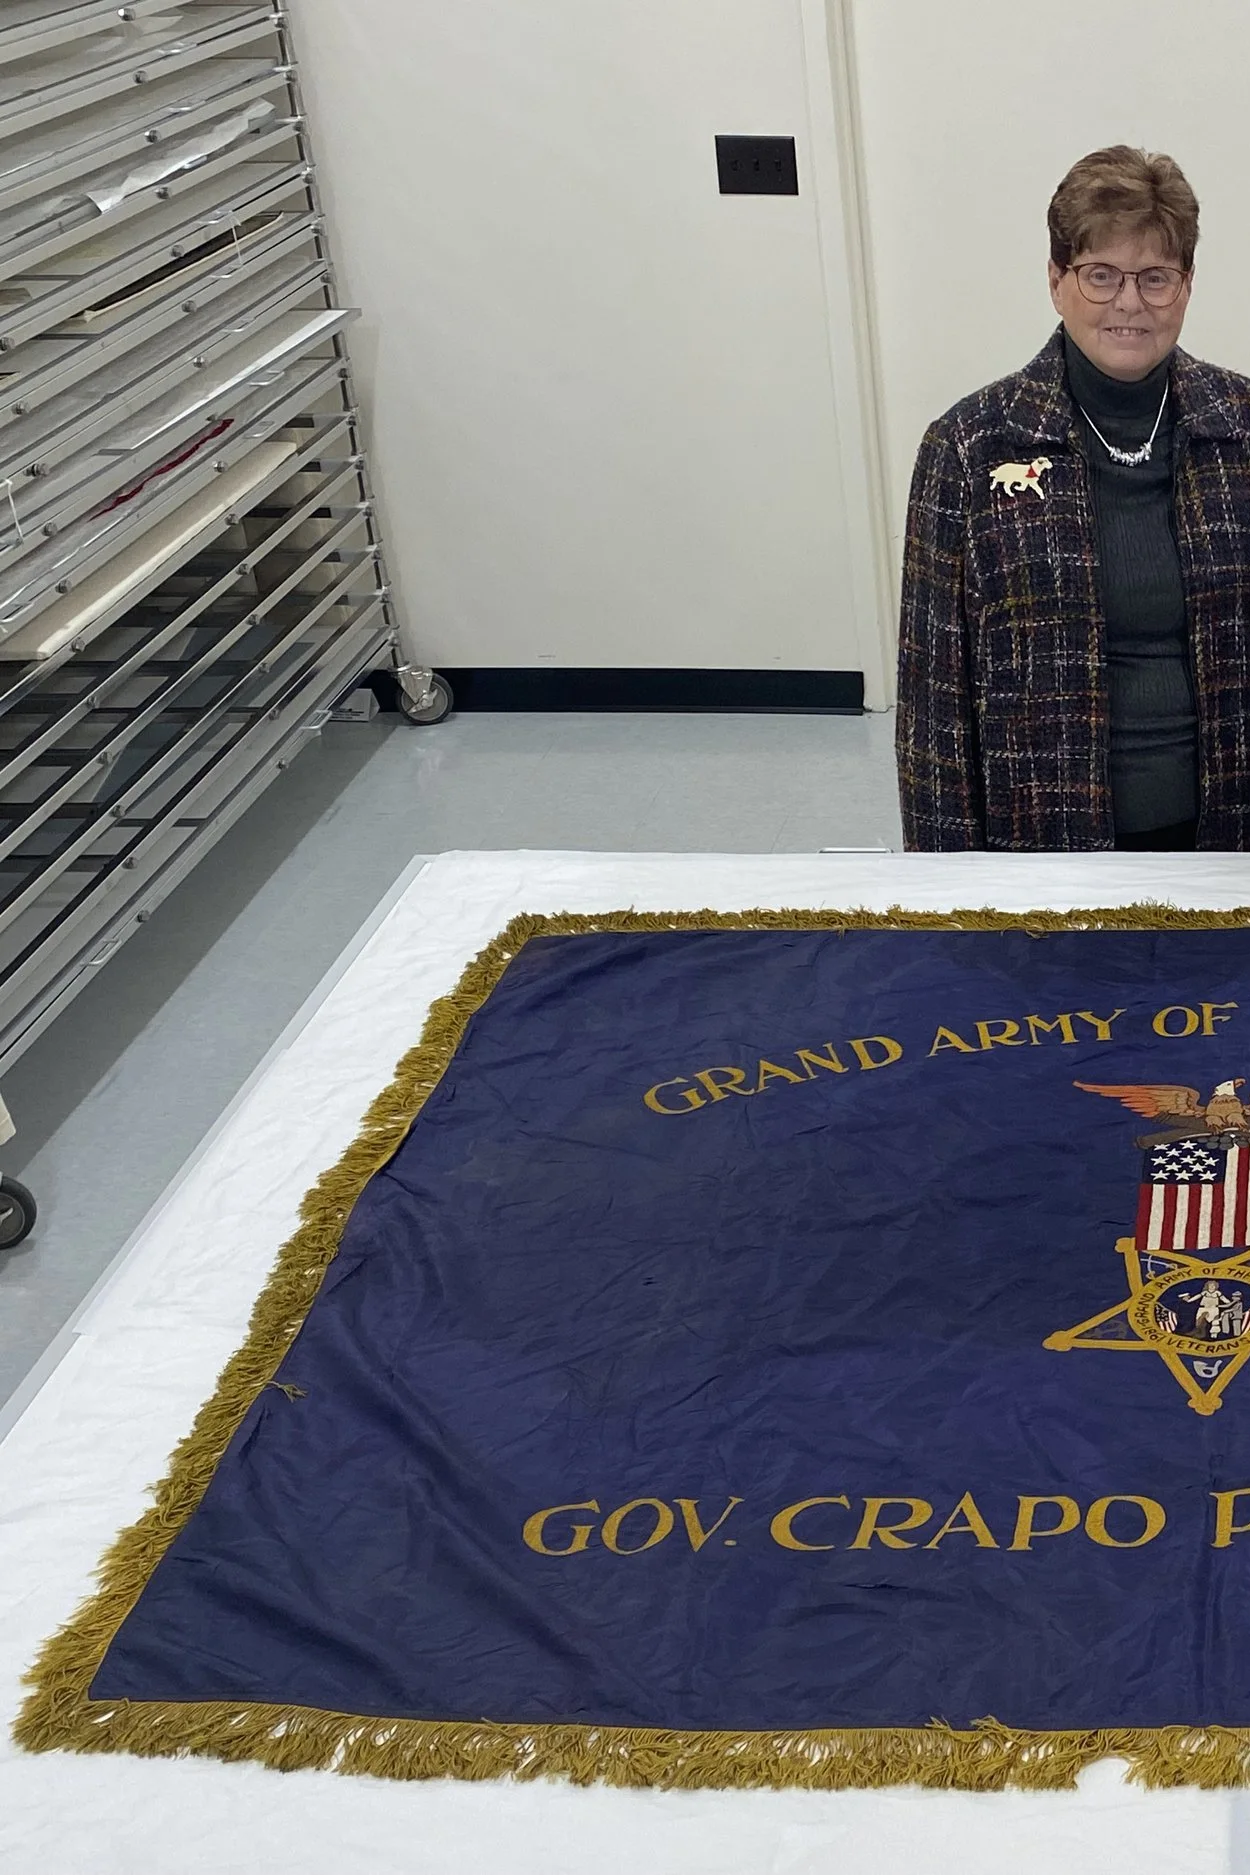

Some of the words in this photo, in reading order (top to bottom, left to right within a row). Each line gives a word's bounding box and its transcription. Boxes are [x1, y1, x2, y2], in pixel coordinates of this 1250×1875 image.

[643, 1035, 904, 1115] GRAND
[926, 1008, 1126, 1057] ARMY
[1152, 1001, 1238, 1038] OF
[1134, 1292, 1155, 1325] GRAND
[1155, 1268, 1193, 1289] ARMY
[1202, 1267, 1220, 1275] OF
[521, 1496, 745, 1557] GOV.
[769, 1491, 1167, 1552] CRAPO
